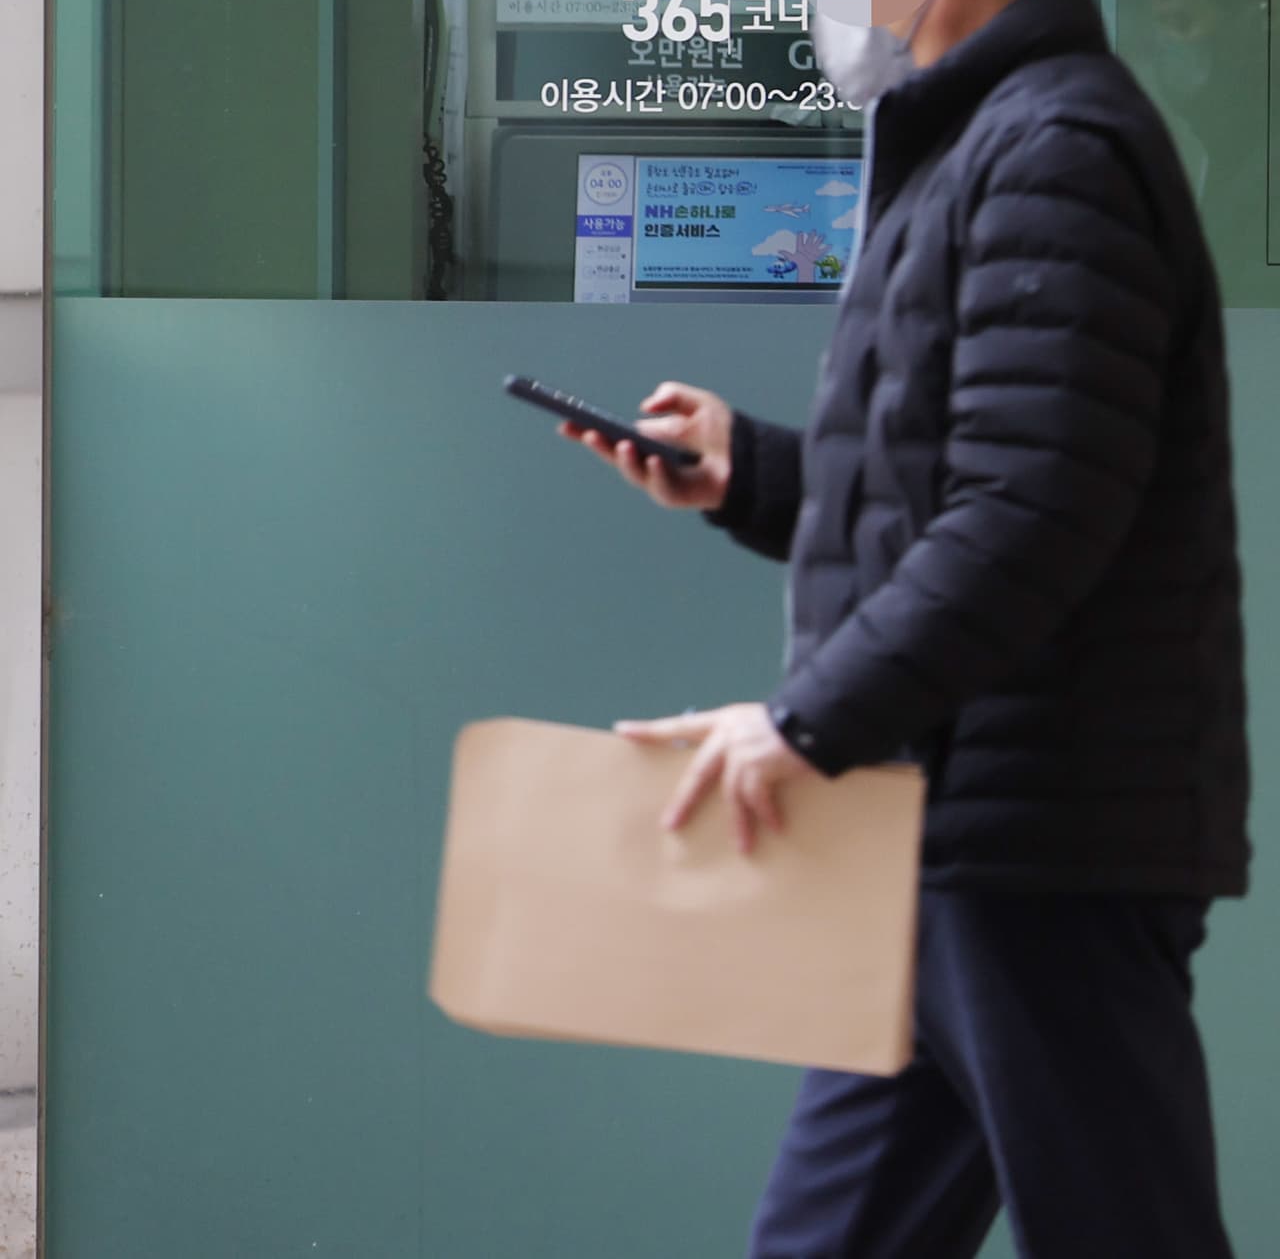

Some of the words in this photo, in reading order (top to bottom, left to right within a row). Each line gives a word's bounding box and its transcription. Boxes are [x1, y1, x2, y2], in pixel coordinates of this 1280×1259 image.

[627, 36, 744, 69] 오만원권
[541, 79, 666, 112] 이용시간
[678, 82, 863, 111] 07:00~23:
[645, 205, 736, 219] NH손하나로
[583, 218, 625, 231] 사용가능
[644, 224, 721, 238] 인증서비스
